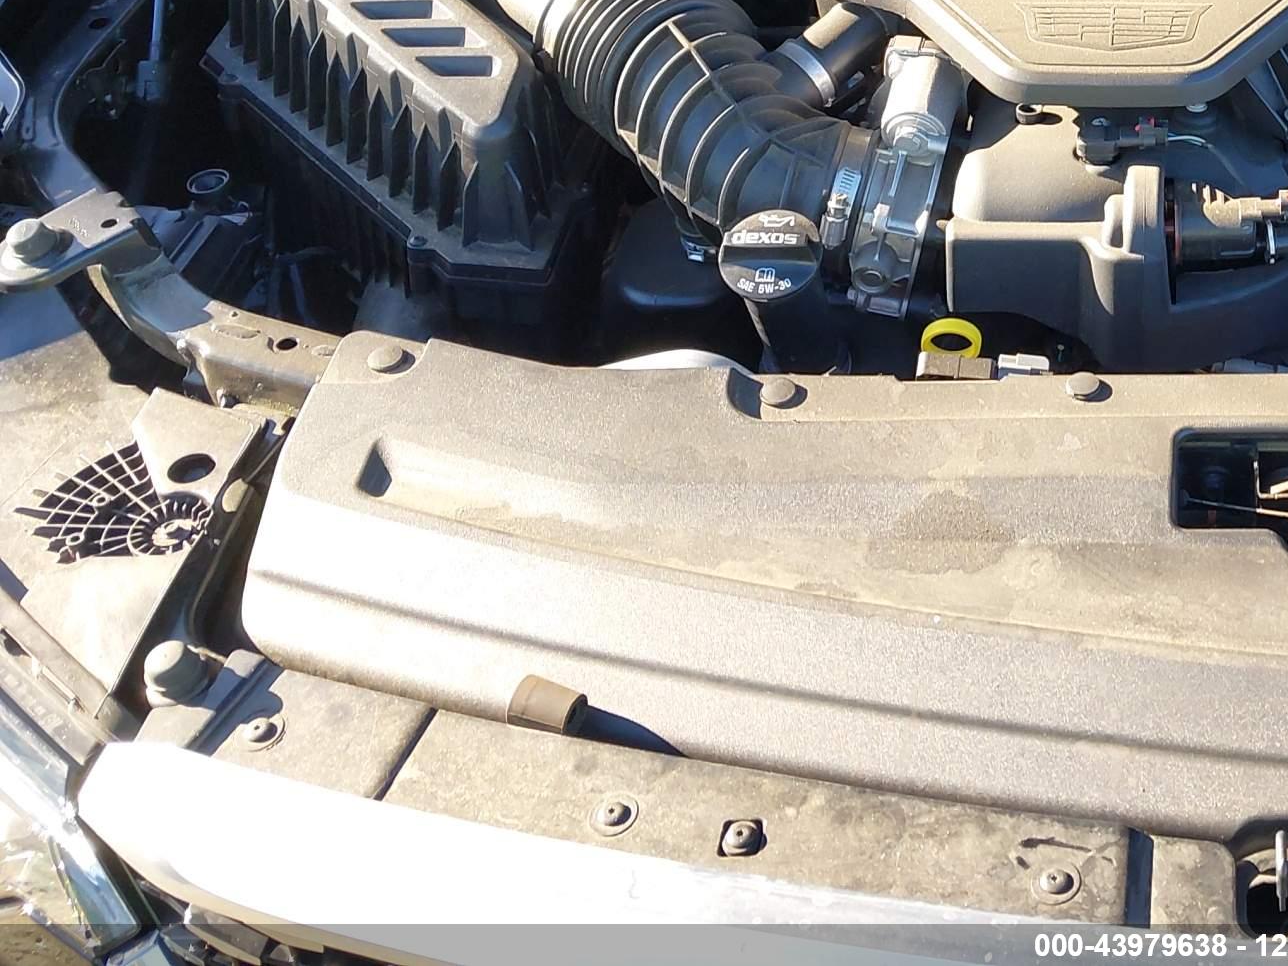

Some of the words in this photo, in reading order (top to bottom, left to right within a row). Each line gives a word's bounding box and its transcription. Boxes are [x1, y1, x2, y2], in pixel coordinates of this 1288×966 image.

[732, 230, 798, 244] dexos
[737, 279, 755, 292] SAE
[758, 279, 791, 293] 5W-30
